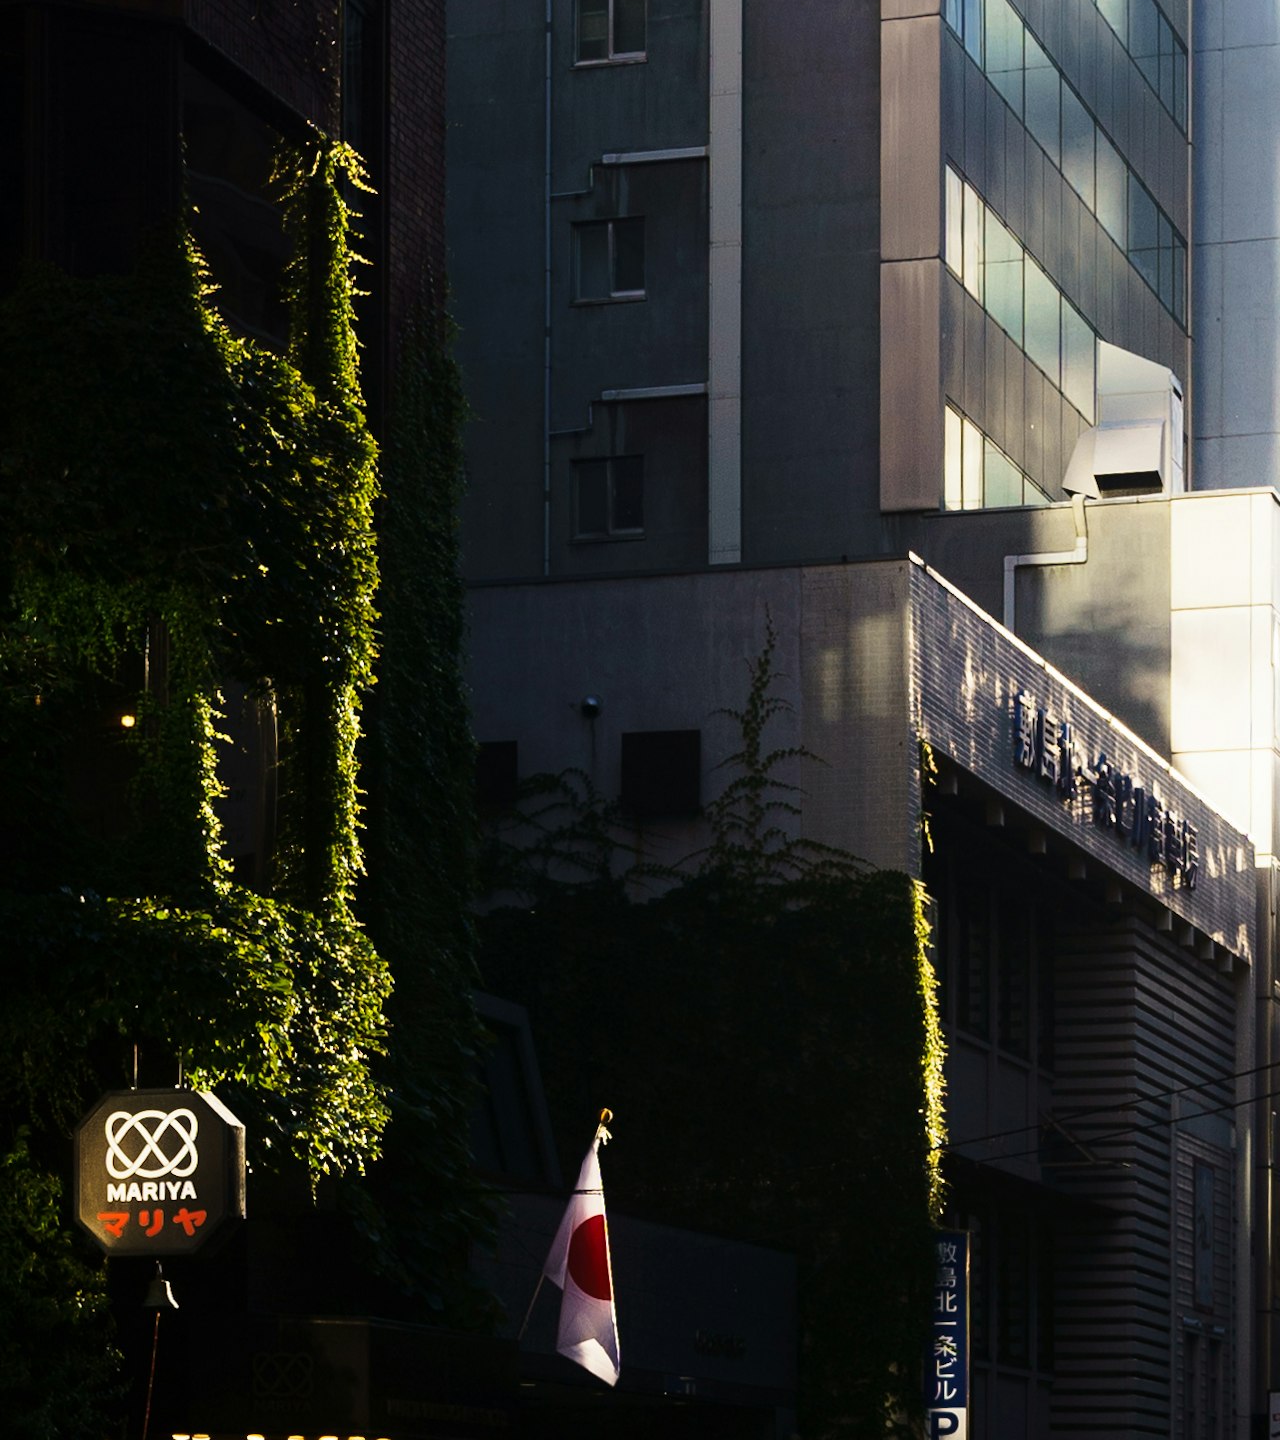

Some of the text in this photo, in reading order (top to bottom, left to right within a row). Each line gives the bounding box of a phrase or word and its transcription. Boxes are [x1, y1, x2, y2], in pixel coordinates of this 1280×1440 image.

[107, 1181, 197, 1202] MARIYA
[97, 1208, 207, 1237] マリヤ
[933, 1242, 958, 1402] 敷島北一条ビル
